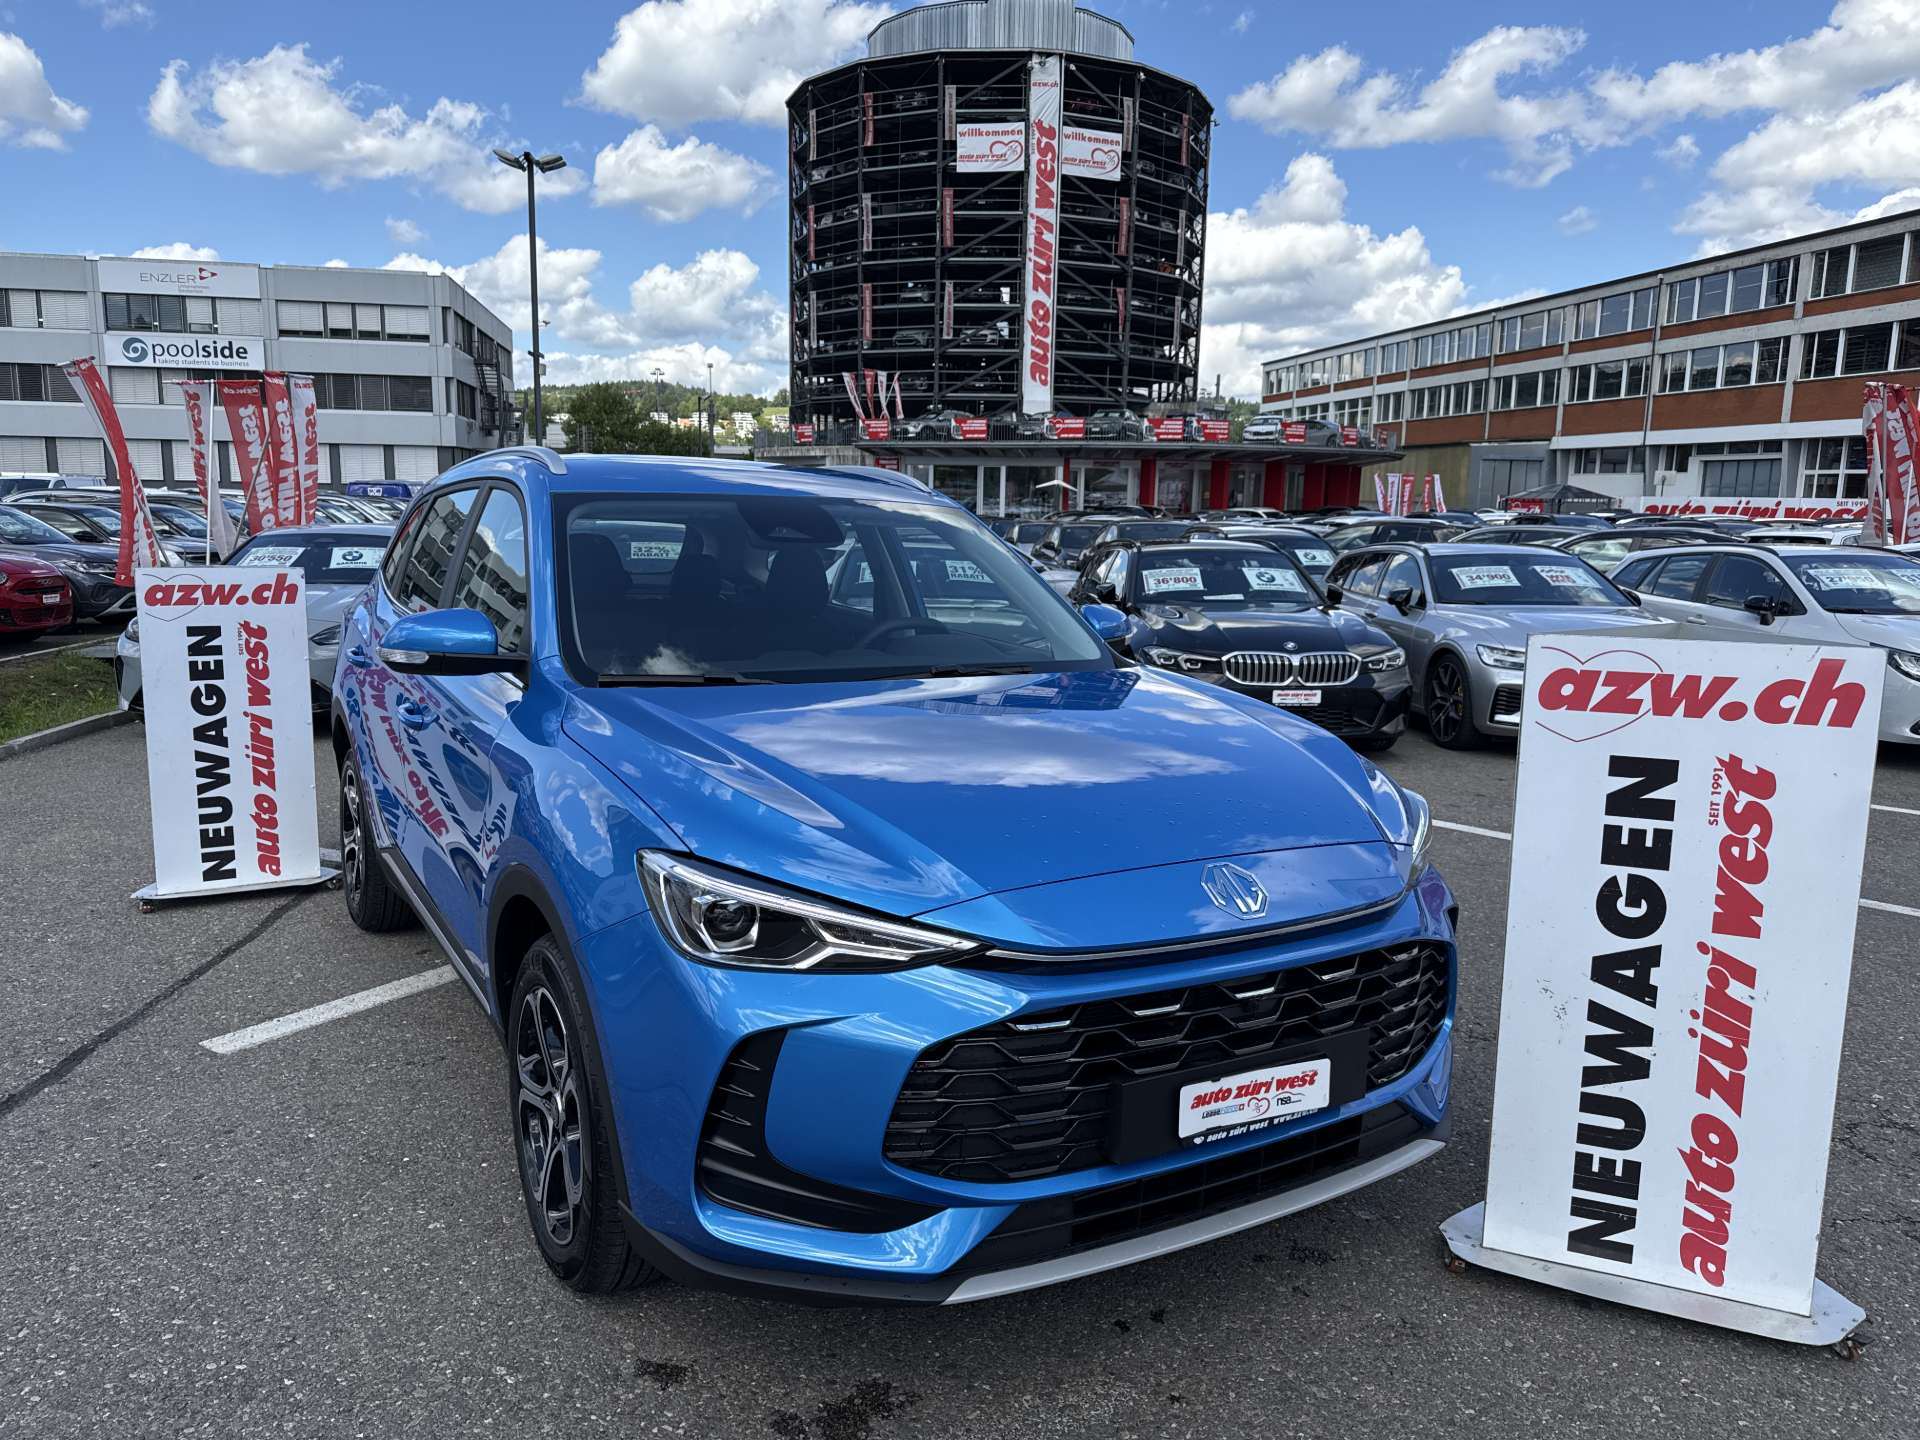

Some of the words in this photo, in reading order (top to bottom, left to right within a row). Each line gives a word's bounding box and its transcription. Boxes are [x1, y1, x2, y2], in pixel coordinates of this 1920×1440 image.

[958, 127, 1024, 138] willkommen
[1035, 119, 1057, 209] west
[1063, 131, 1121, 147] willkommen
[140, 272, 196, 284] ENZLER
[1028, 213, 1055, 300] züri
[152, 339, 248, 364] poolside
[181, 359, 210, 367] students
[221, 360, 250, 368] business
[1027, 300, 1050, 387] auto
[144, 573, 299, 606] azw.ch
[1152, 576, 1198, 585] 36'800
[238, 620, 272, 707] west
[1537, 658, 1866, 729] azw.ch
[186, 625, 236, 881] NEUWAGEN
[242, 711, 276, 792] züri
[1711, 768, 1723, 796] 1991
[249, 793, 282, 877] auto
[1708, 801, 1720, 826] SEIT
[1711, 753, 1777, 940] west
[1567, 754, 1680, 1264] NEUWAGEN
[1687, 940, 1757, 1119] züri
[1190, 1085, 1233, 1110] auto
[1232, 1077, 1275, 1100] züri
[1275, 1070, 1319, 1092] west
[1206, 1131, 1228, 1143] auto
[1229, 1125, 1248, 1137] züri
[1250, 1119, 1269, 1132] west
[1677, 1112, 1739, 1288] auto
